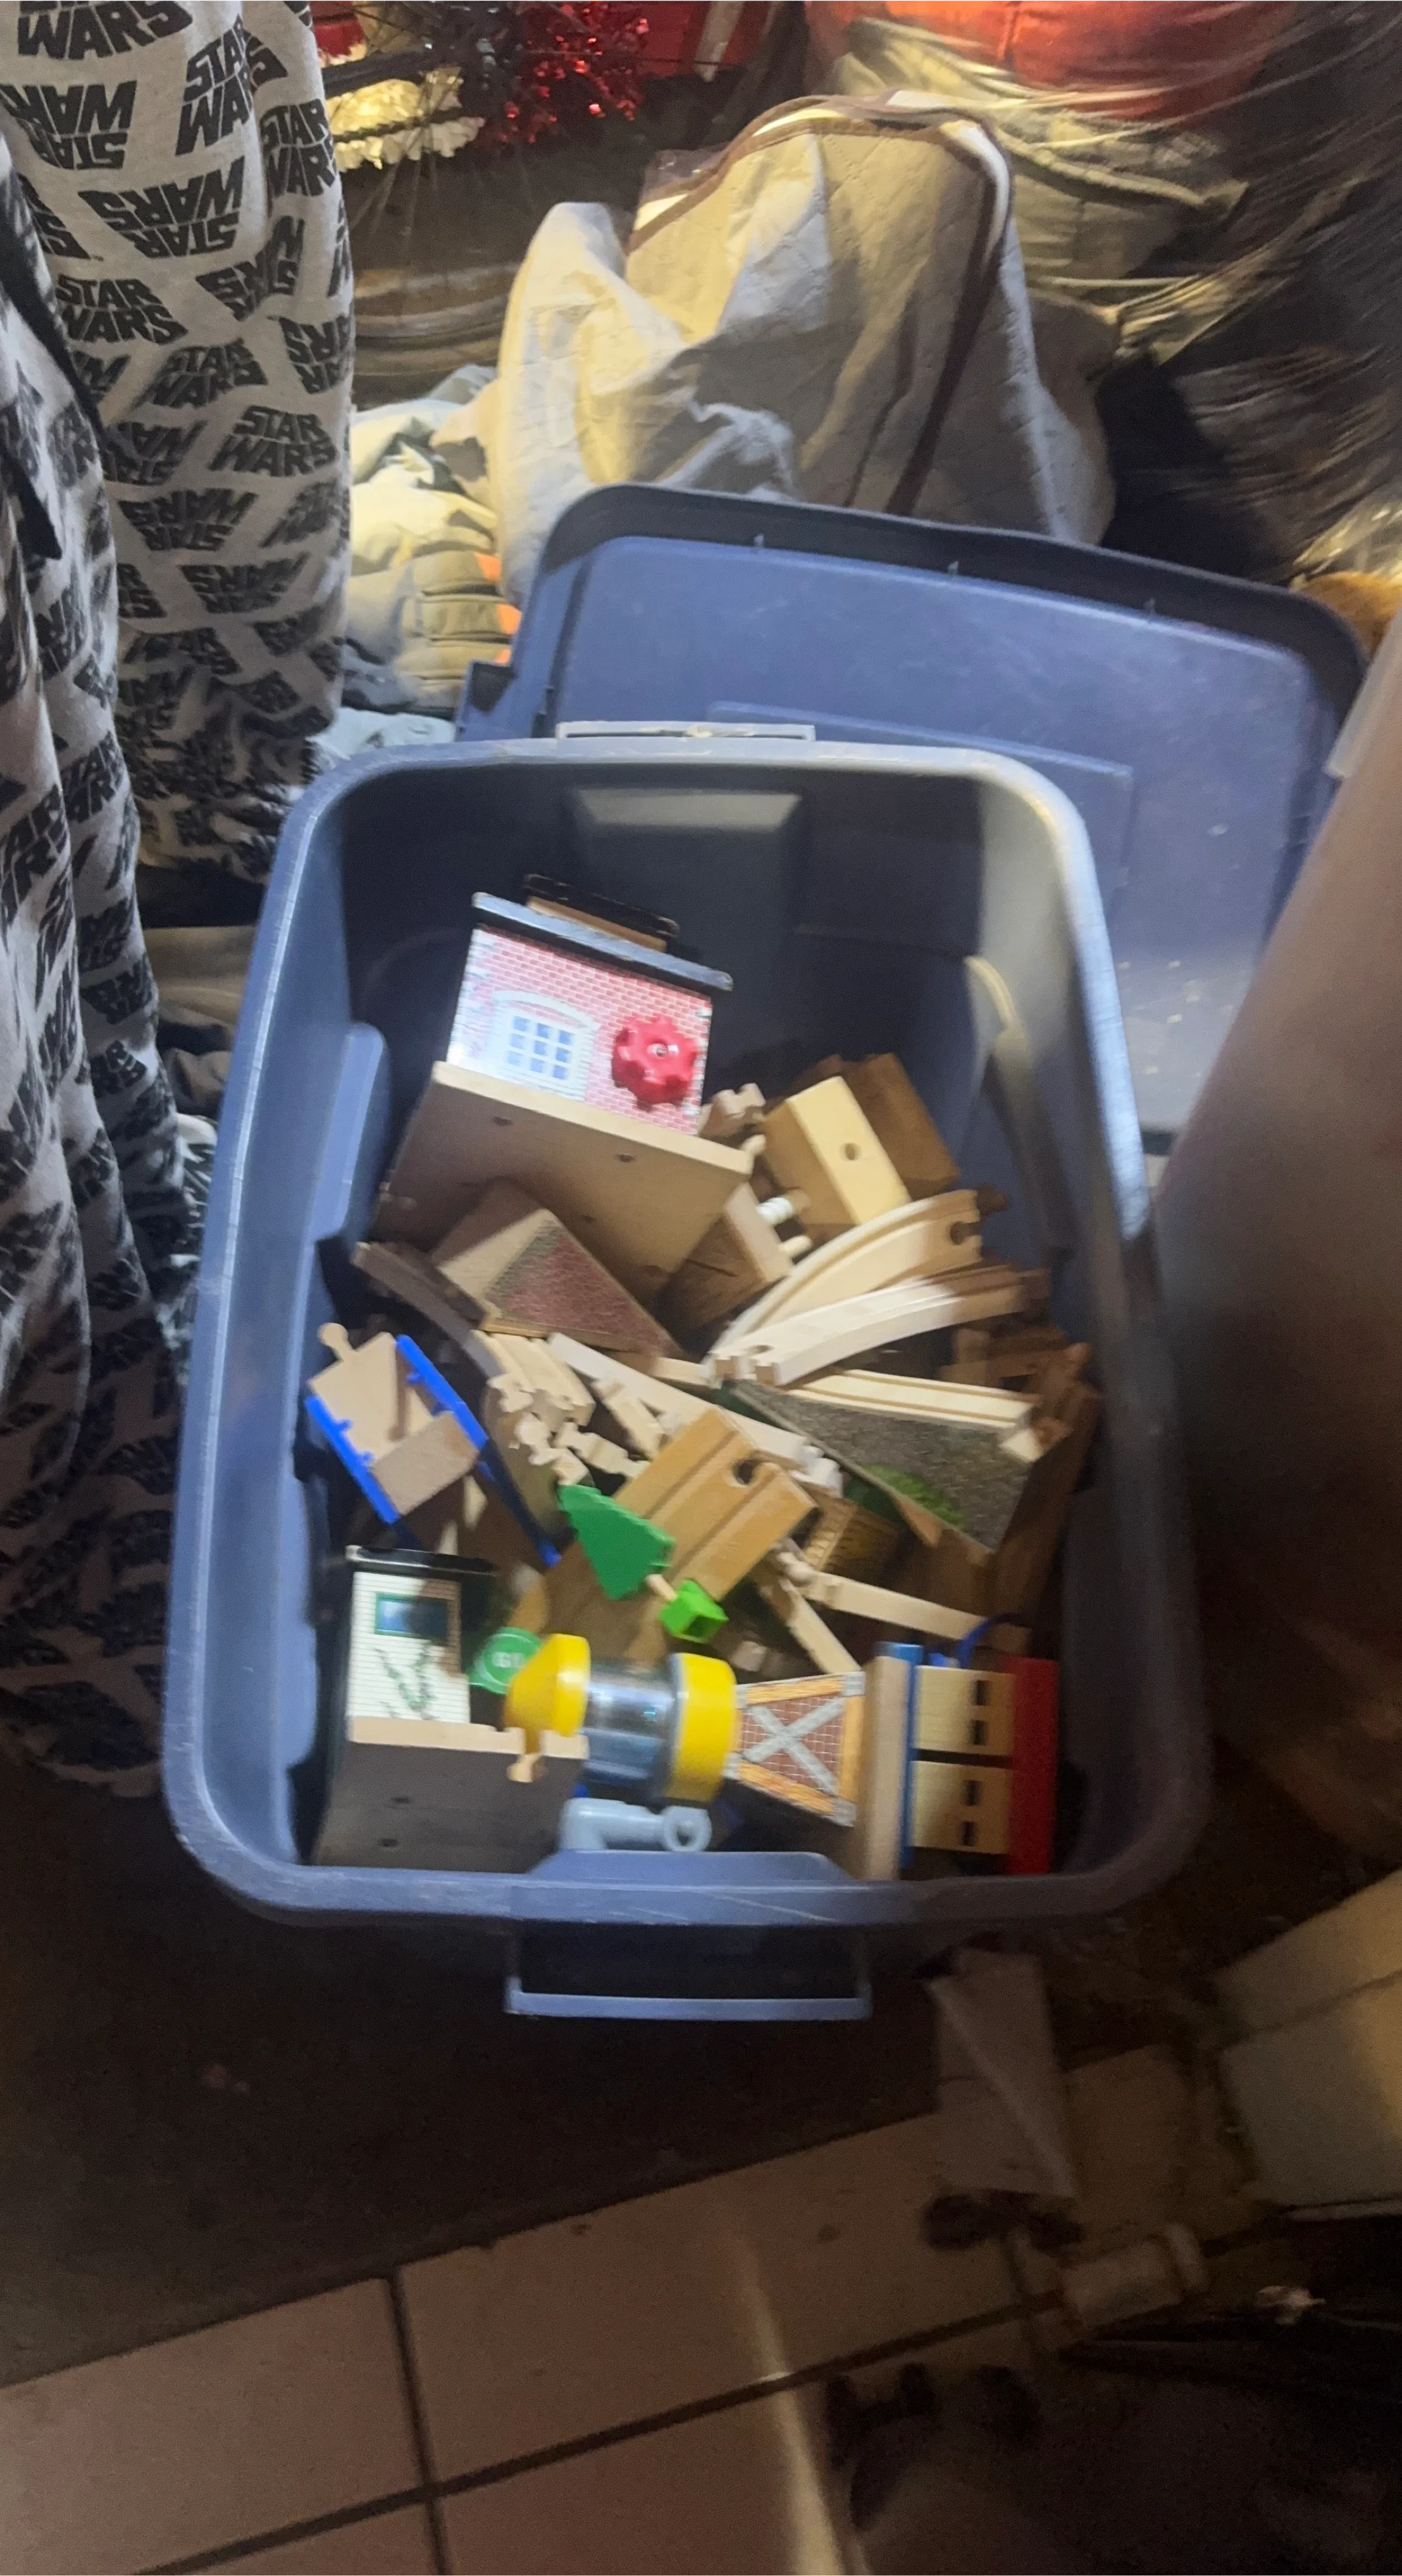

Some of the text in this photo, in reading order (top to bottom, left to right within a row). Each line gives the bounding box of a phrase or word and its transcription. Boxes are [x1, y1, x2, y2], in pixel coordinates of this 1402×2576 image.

[17, 0, 193, 60] WARS
[260, 98, 333, 145] STAR
[78, 155, 246, 234] WARS
[119, 211, 239, 258] STAR
[57, 274, 162, 307] STAR
[231, 405, 324, 445] STAR
[207, 434, 337, 477] WARS
[117, 487, 260, 526] WARS
[137, 521, 234, 551] STAR
